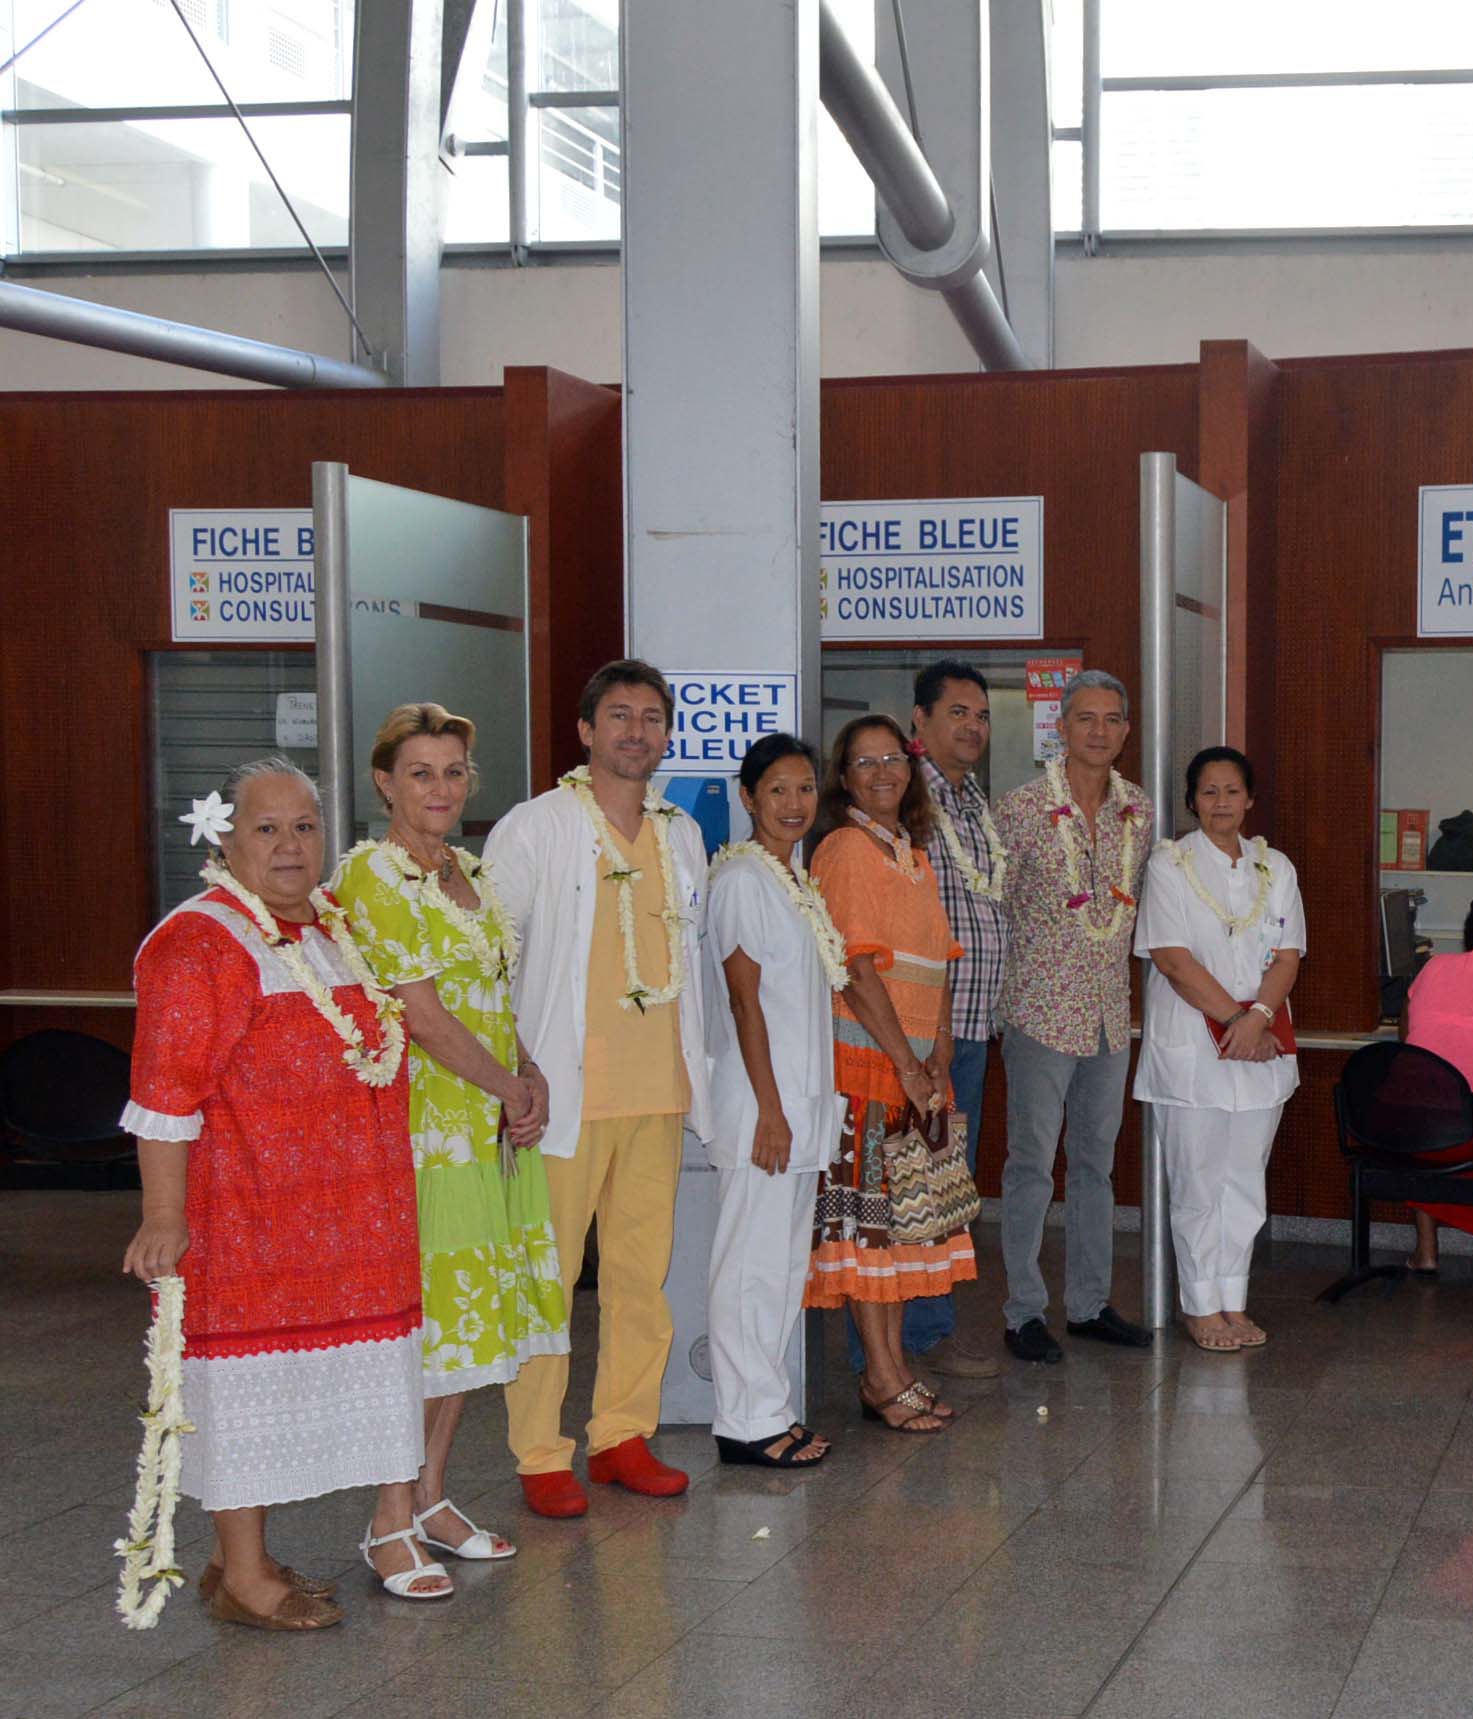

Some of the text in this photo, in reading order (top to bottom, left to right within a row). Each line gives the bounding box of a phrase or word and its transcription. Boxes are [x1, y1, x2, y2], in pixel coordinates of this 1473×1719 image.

[192, 526, 281, 557] FICHE
[919, 517, 1019, 550] BLEUE
[218, 571, 316, 594] HOSPITAL
[837, 564, 1024, 591] HOSPITALISATION
[837, 594, 1025, 621] CONSULTATIONS
[668, 682, 787, 706] ICKET
[677, 710, 779, 734] ICHE
[661, 738, 752, 761] BLEU
